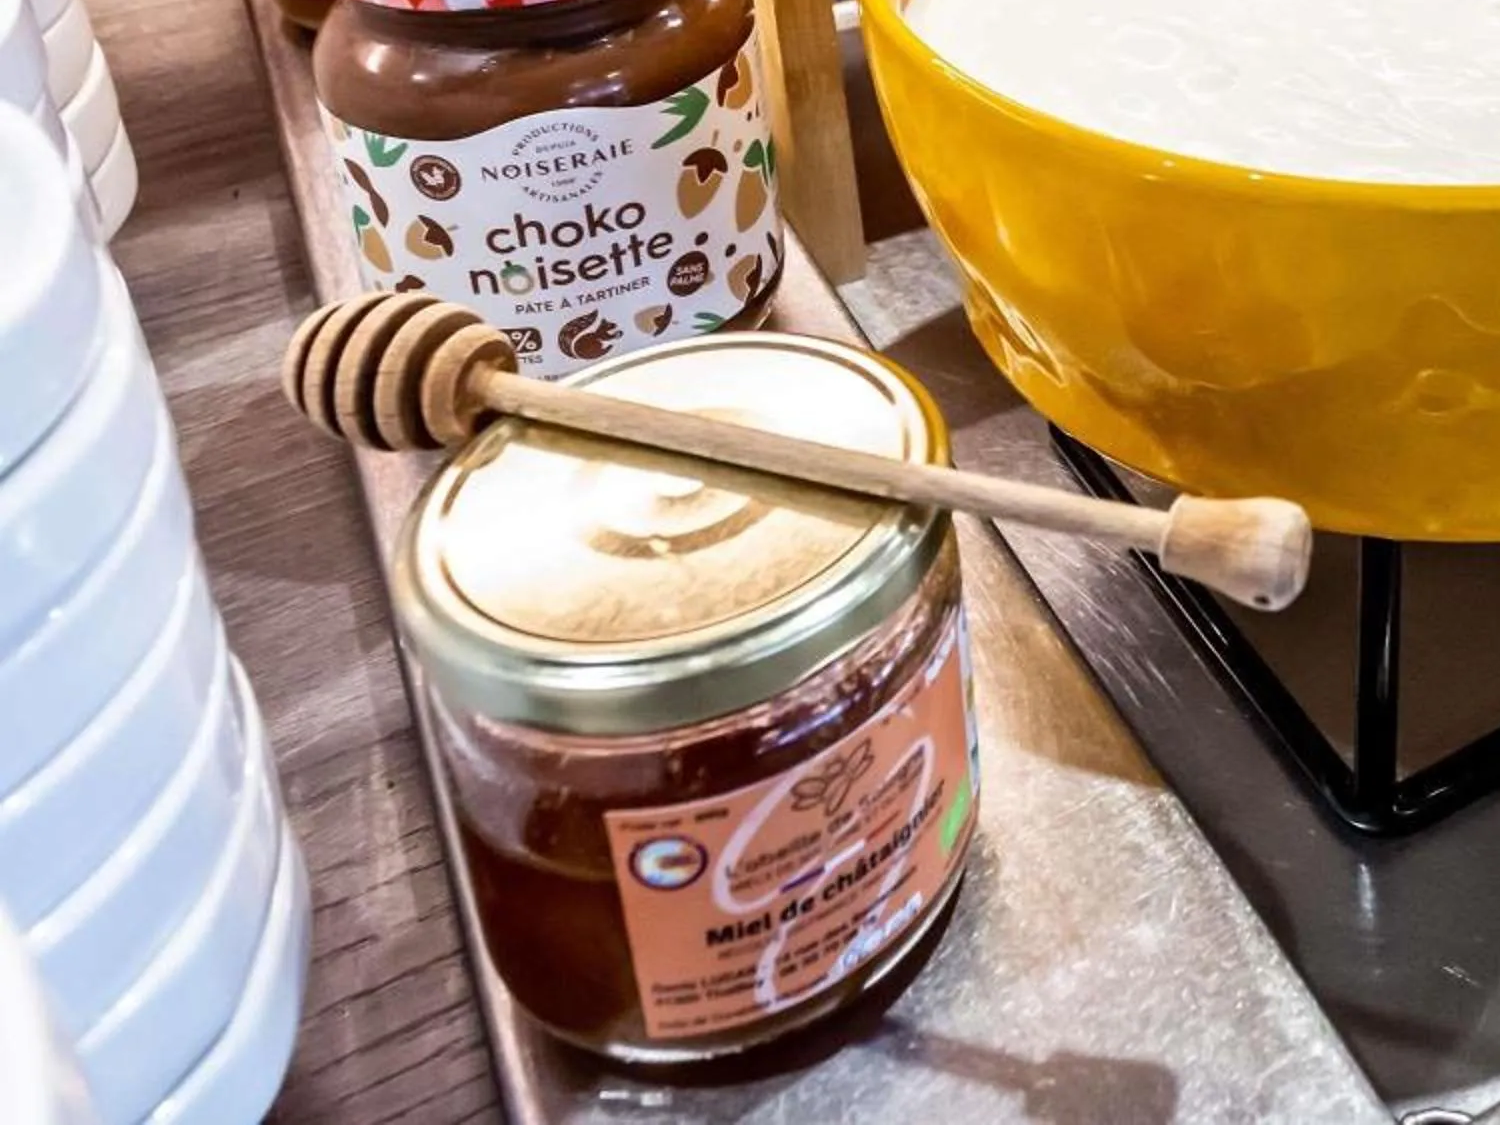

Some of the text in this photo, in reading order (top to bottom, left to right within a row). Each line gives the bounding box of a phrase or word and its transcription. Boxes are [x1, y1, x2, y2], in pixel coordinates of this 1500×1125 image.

[480, 137, 634, 183] NOISERAIE
[485, 202, 646, 255] choko
[469, 231, 673, 296] noisette
[575, 276, 651, 306] TARTINER
[705, 912, 770, 947] Miel
[779, 897, 814, 922] de
